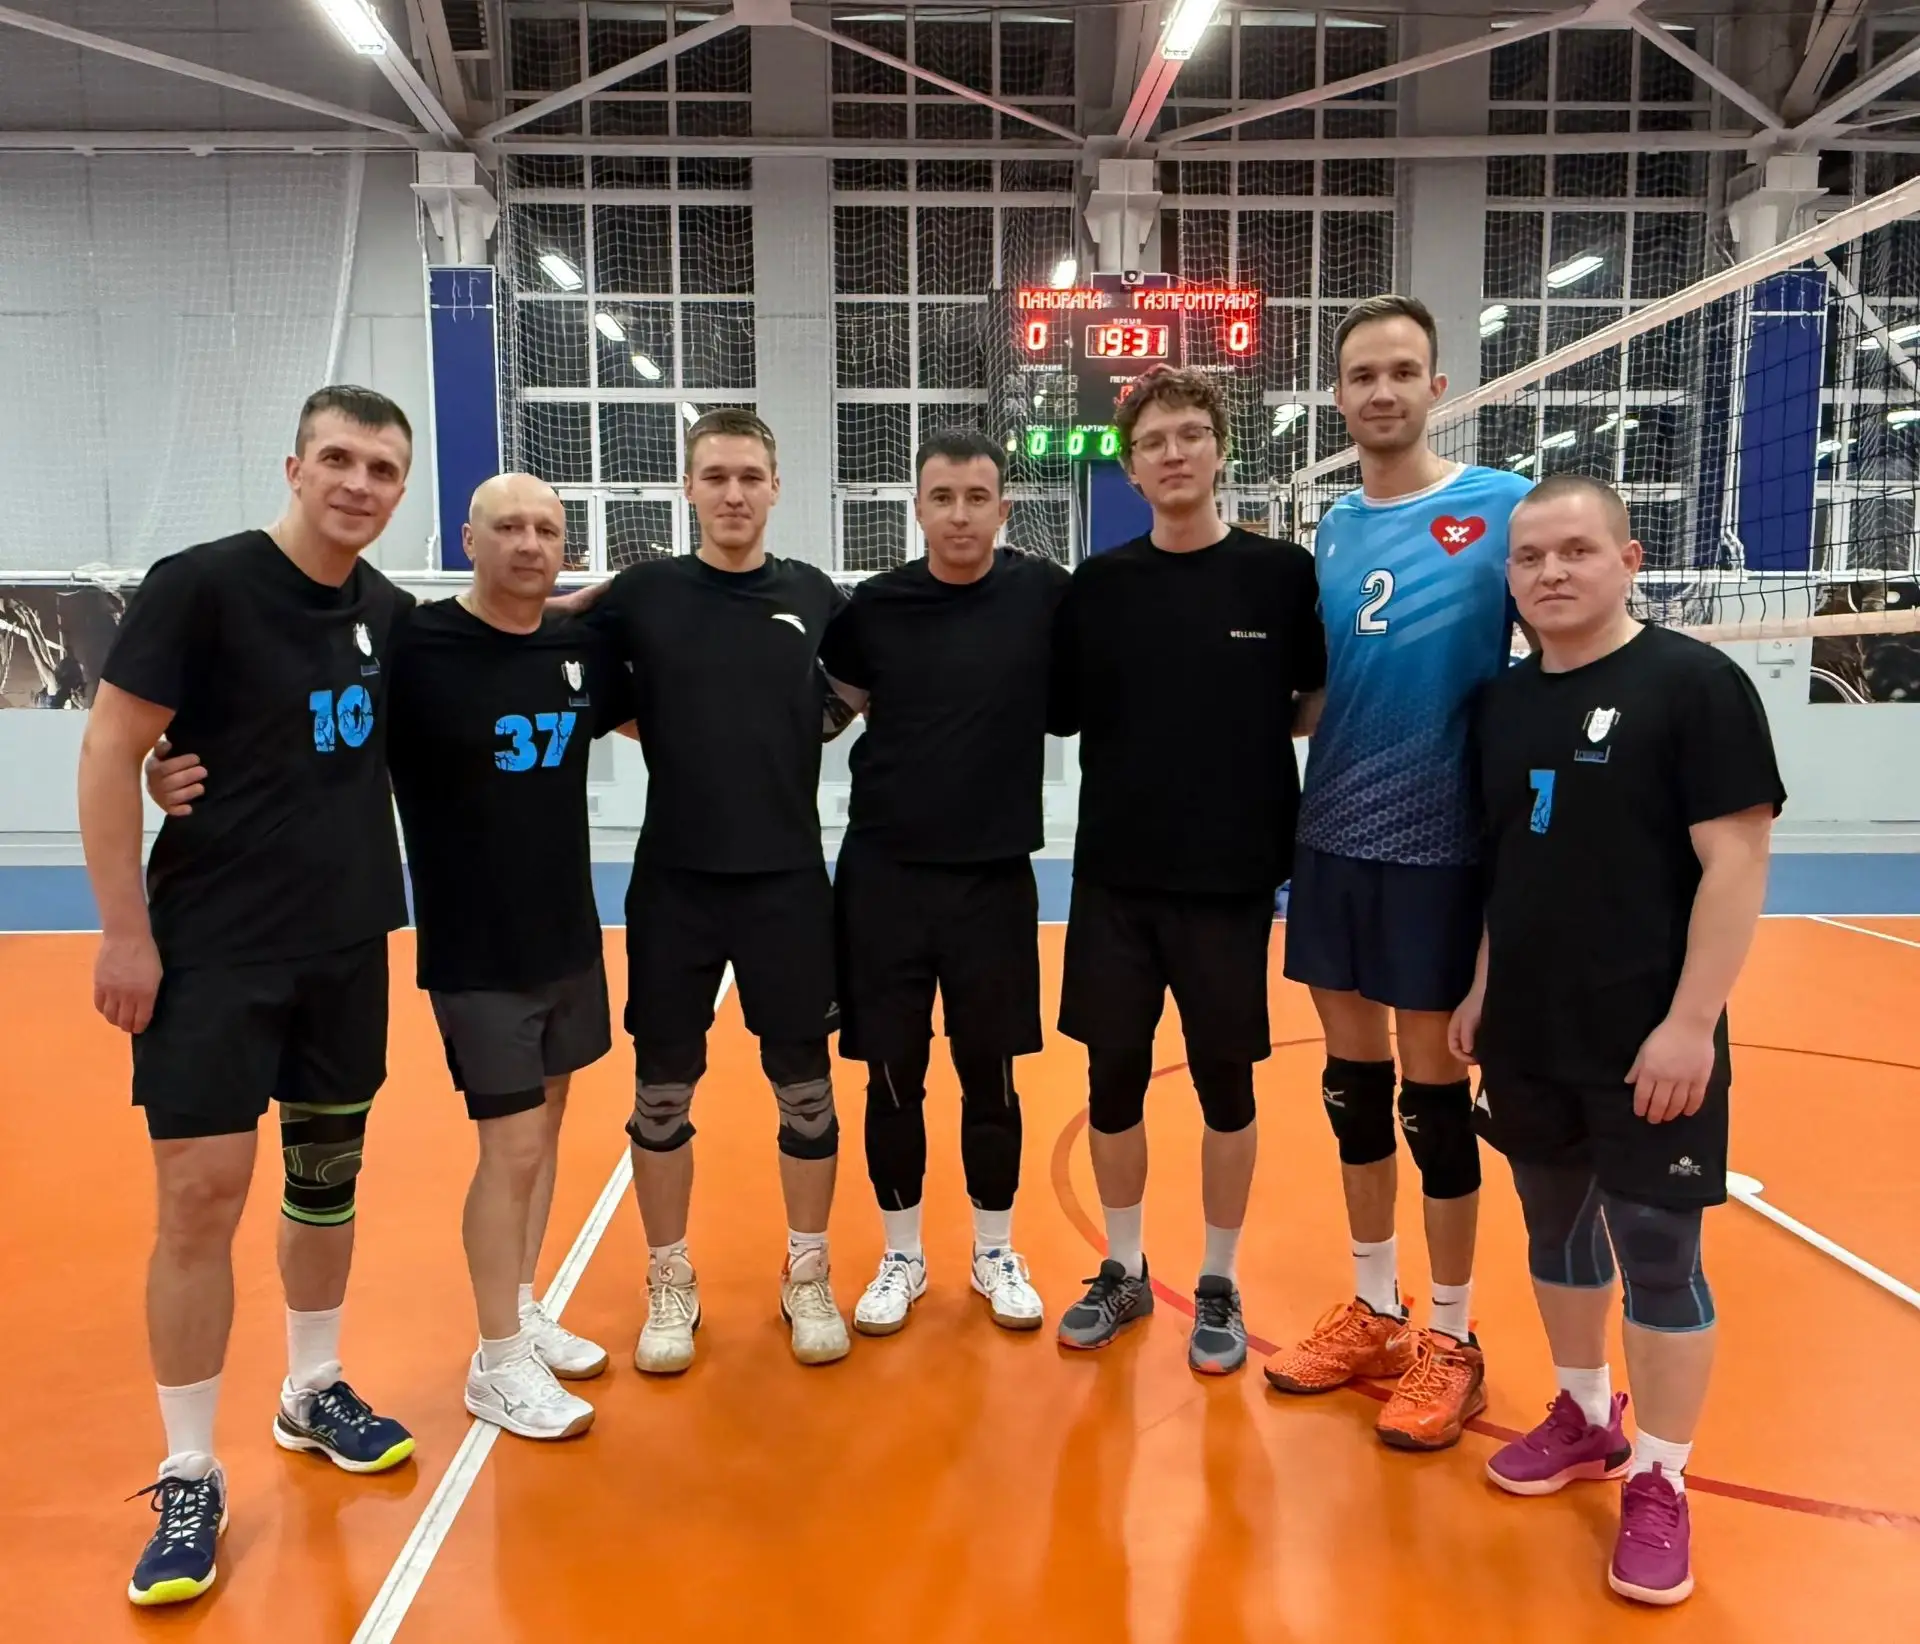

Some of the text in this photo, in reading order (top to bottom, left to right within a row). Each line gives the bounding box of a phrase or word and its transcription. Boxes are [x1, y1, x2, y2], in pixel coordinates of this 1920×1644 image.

[1019, 291, 1103, 310] ПАНОРАМА
[1133, 291, 1257, 310] ГАЗПРОМТРАНС
[1028, 322, 1047, 350] 0
[1097, 327, 1165, 356] 19:31
[1229, 322, 1249, 351] 0
[1030, 431, 1117, 456] 0 0 0
[1355, 569, 1395, 636] 2
[309, 684, 374, 752] 10
[494, 711, 577, 772] 37
